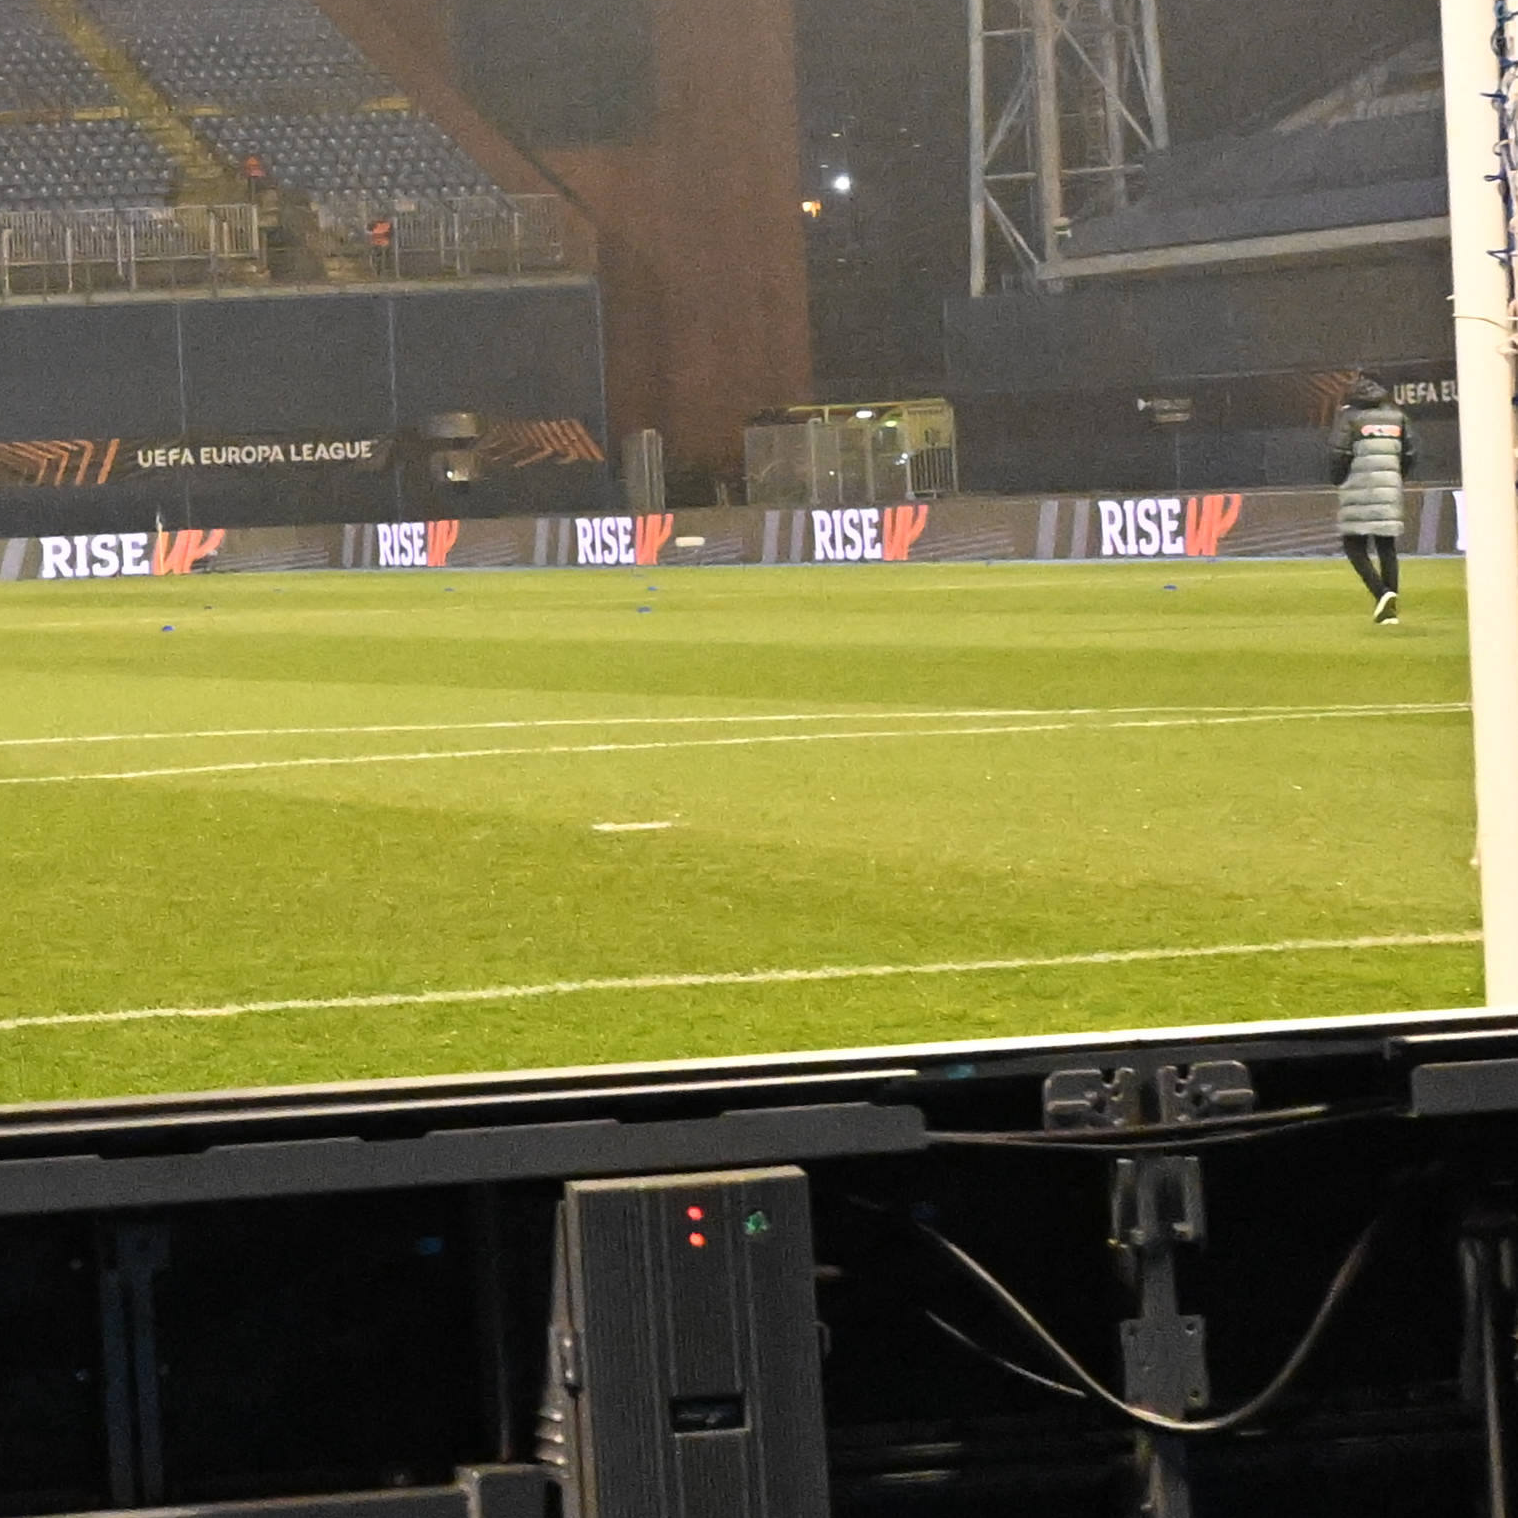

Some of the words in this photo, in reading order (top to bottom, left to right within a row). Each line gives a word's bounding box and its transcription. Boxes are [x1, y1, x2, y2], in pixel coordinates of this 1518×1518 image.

[1393, 382, 1439, 405] UEFA
[137, 447, 194, 468] UEFA
[199, 444, 285, 465] EUROPA
[290, 440, 373, 462] LEAGUE
[376, 521, 428, 566] RISE
[427, 519, 460, 567] UP
[575, 516, 635, 564] RISE
[635, 513, 674, 566] UP
[811, 507, 883, 560] RISE
[883, 504, 929, 561] UP
[1098, 498, 1185, 556] RISE
[1185, 493, 1242, 557] UP
[39, 532, 151, 579] RISE
[152, 528, 226, 576] UP
